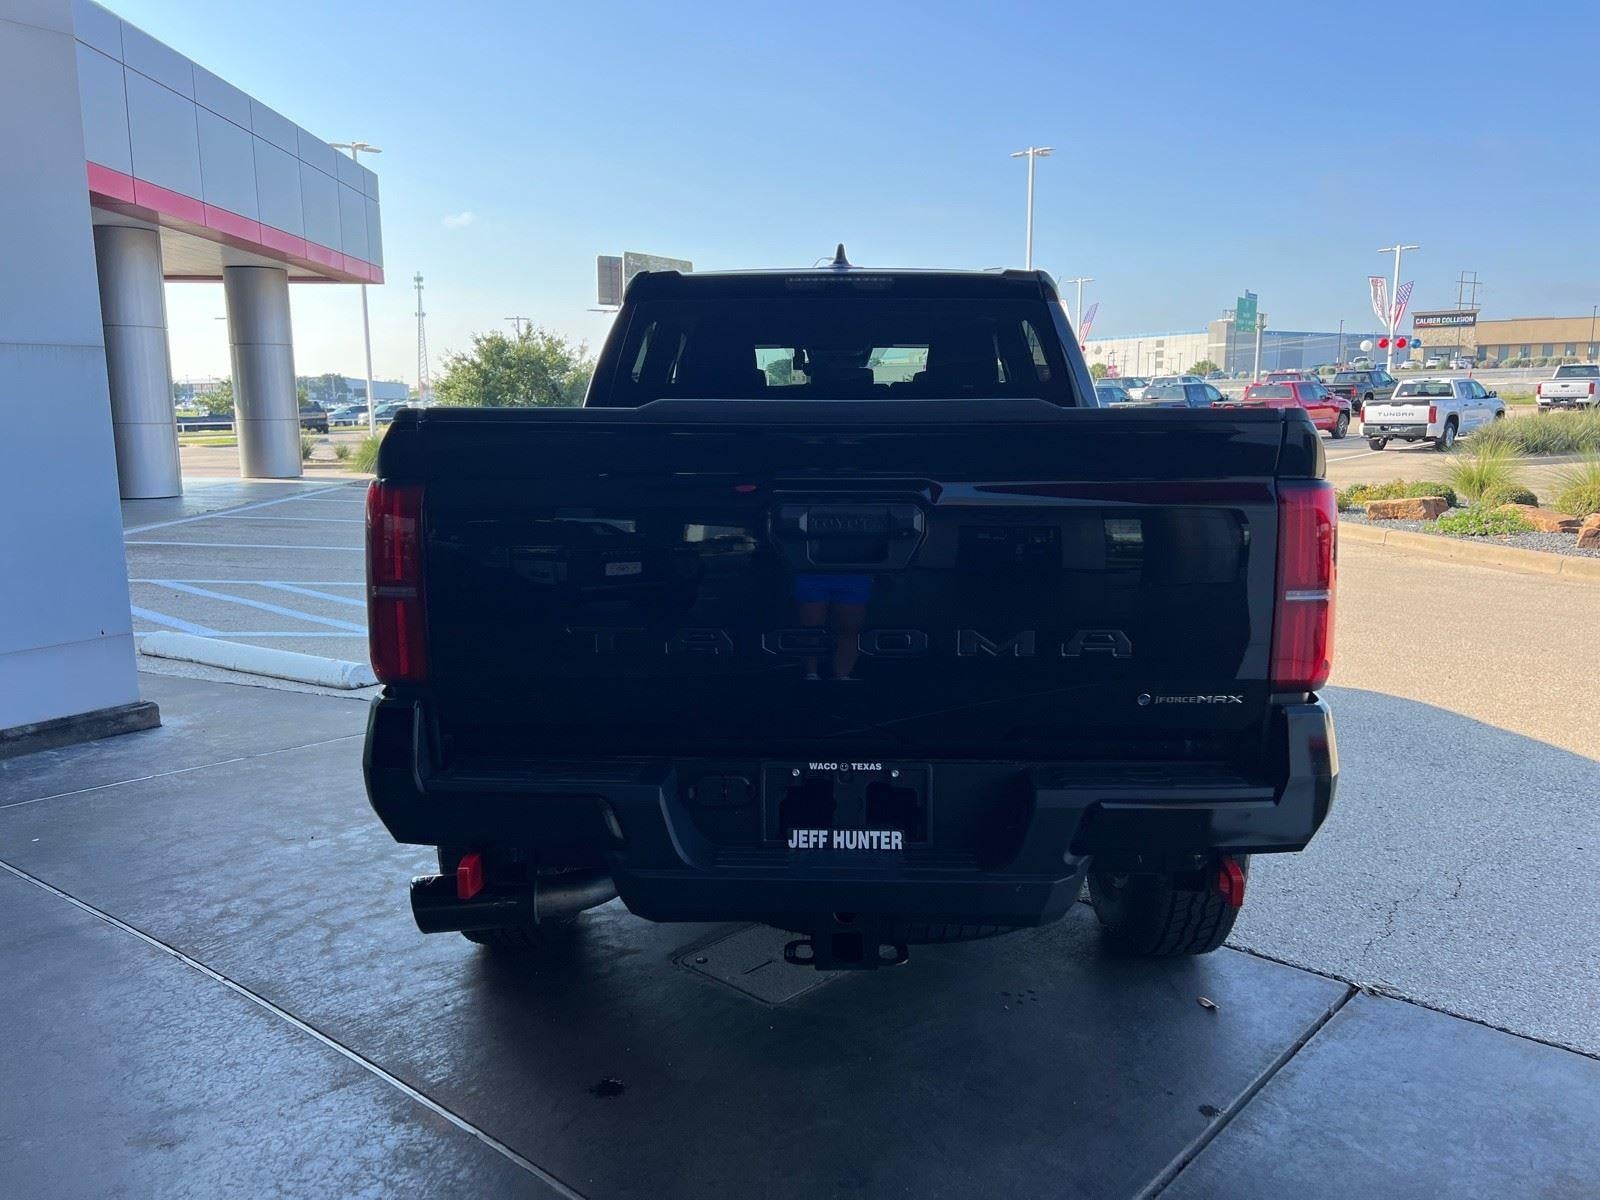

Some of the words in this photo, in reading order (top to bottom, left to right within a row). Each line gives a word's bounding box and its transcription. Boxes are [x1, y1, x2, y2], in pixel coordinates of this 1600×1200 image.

[1415, 317, 1441, 325] CALIBER
[1441, 315, 1474, 324] COLLISION
[564, 626, 1134, 658] TACOMA
[808, 762, 838, 770] WACO
[850, 762, 882, 771] TEXAS
[788, 829, 829, 849] JEFF
[832, 829, 903, 850] HUNTER
